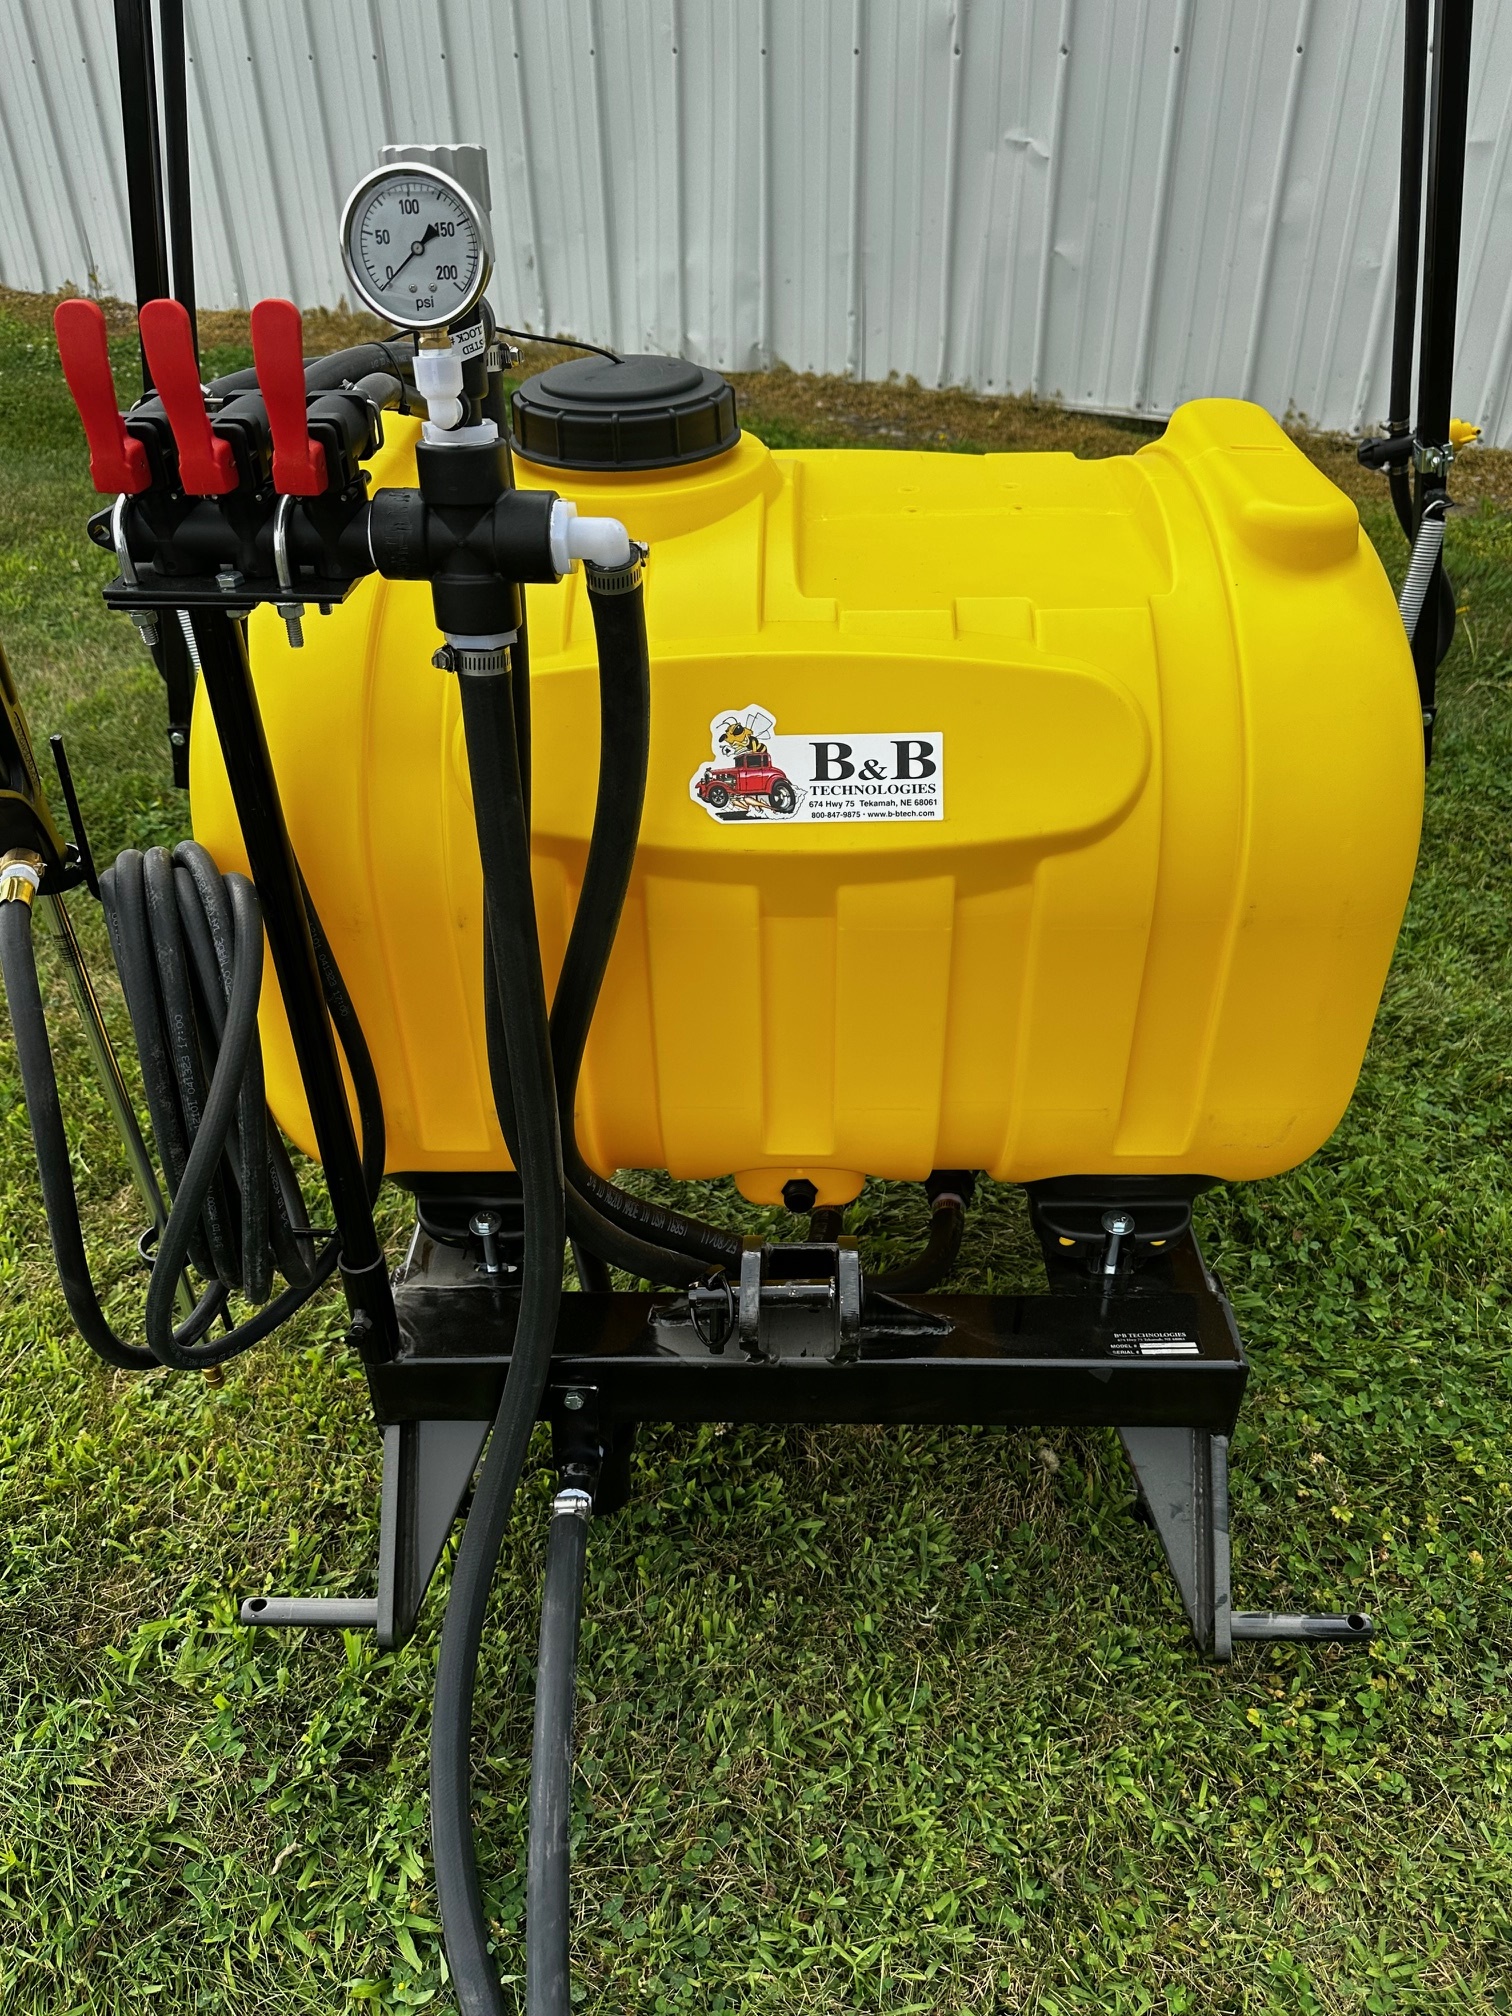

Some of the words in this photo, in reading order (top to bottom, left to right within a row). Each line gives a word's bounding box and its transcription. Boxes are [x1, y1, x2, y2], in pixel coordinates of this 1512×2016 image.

[398, 198, 420, 215] 100
[375, 229, 390, 245] 50
[434, 221, 455, 238] 150
[385, 265, 394, 281] 0
[435, 265, 458, 280] 200
[416, 295, 435, 311] psi
[456, 325, 482, 343] LOCK
[808, 740, 937, 781] B&B
[809, 783, 936, 796] TECHNOLOGIES
[808, 800, 824, 808] 674
[825, 799, 843, 810] Hwy
[845, 799, 855, 807] 75
[859, 799, 899, 809] Tekamah,
[900, 799, 913, 807] NE
[913, 798, 938, 807] 68061
[811, 811, 861, 819] 800-847-9875
[867, 809, 935, 818] www.b-btech.com
[319, 953, 338, 987] 041323
[332, 990, 349, 1018] 17:00
[174, 1014, 188, 1049] 17:00
[181, 1055, 196, 1095] 041323
[622, 1199, 640, 1219] MADE
[640, 1205, 651, 1223] IN
